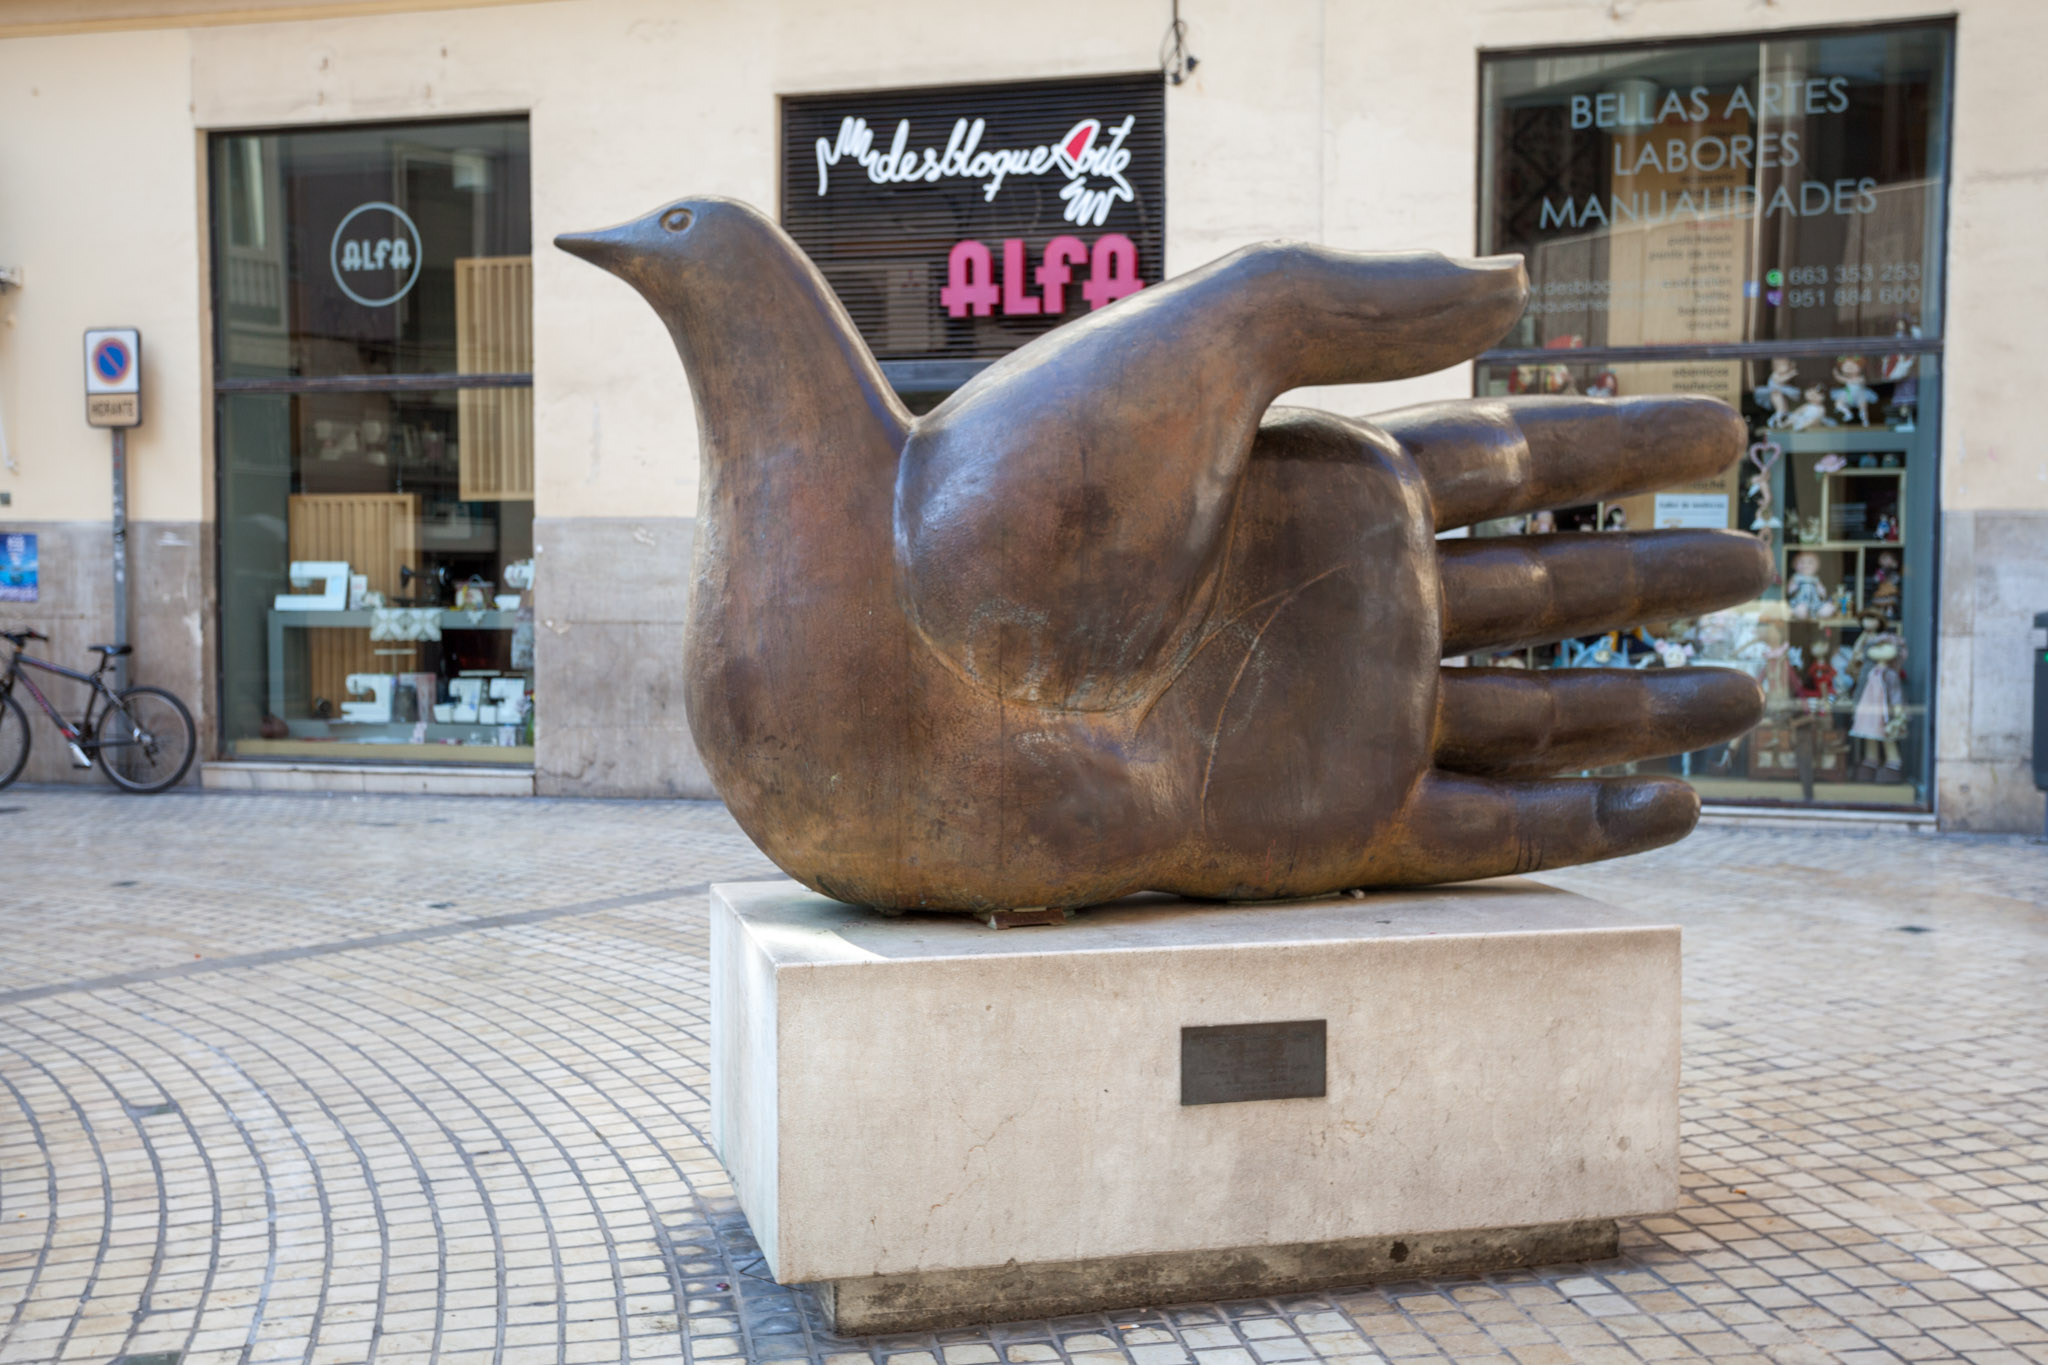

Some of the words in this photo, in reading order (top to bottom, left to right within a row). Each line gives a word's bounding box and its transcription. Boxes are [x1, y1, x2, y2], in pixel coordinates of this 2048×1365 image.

[1571, 86, 1710, 129] BELLAS
[1723, 76, 1850, 119] ARTES
[1614, 131, 1800, 175] LABORES
[1539, 177, 1878, 229] MANUALIDADES
[1788, 265, 1829, 286] 663
